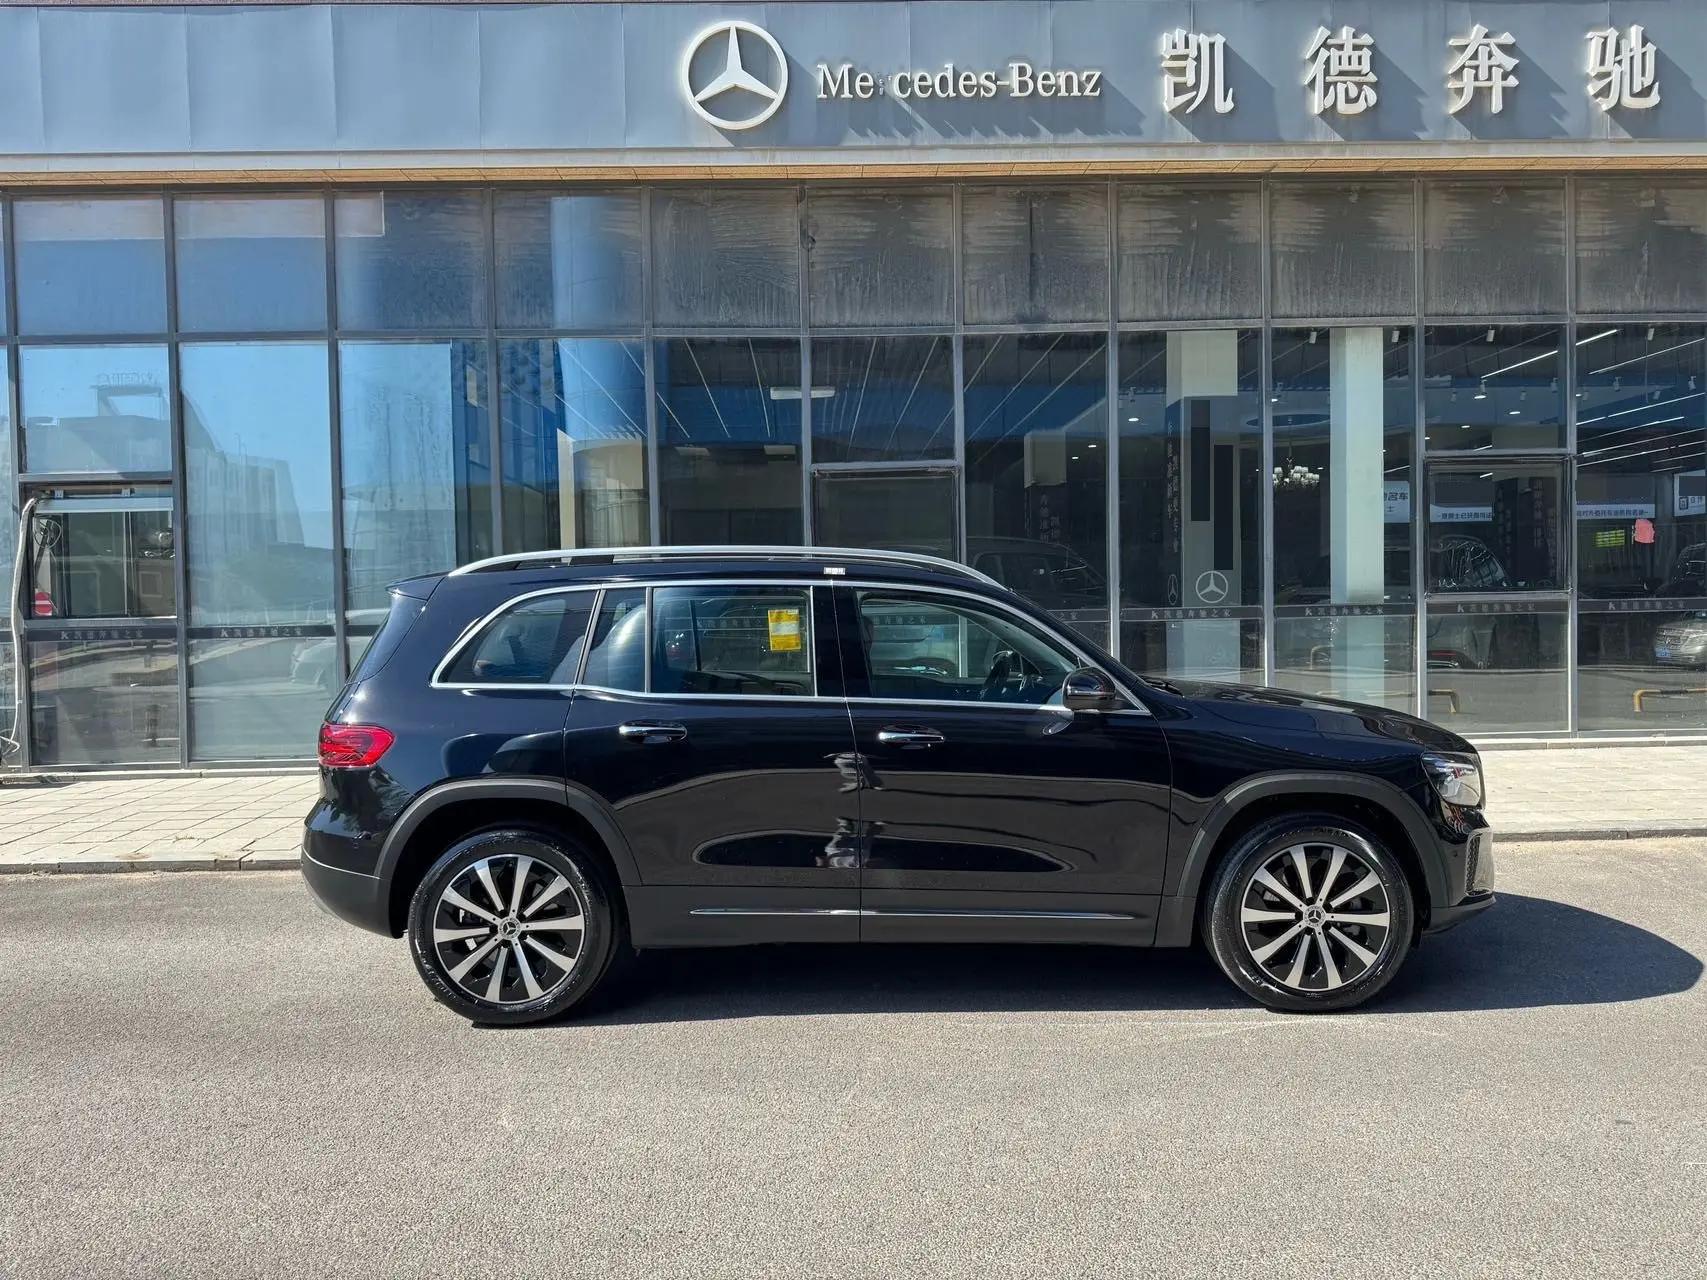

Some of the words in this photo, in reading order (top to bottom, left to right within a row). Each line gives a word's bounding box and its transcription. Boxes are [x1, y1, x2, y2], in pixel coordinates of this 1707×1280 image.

[816, 62, 1102, 100] Mecedes-Benz
[1160, 24, 1661, 115] 凯德奔驰
